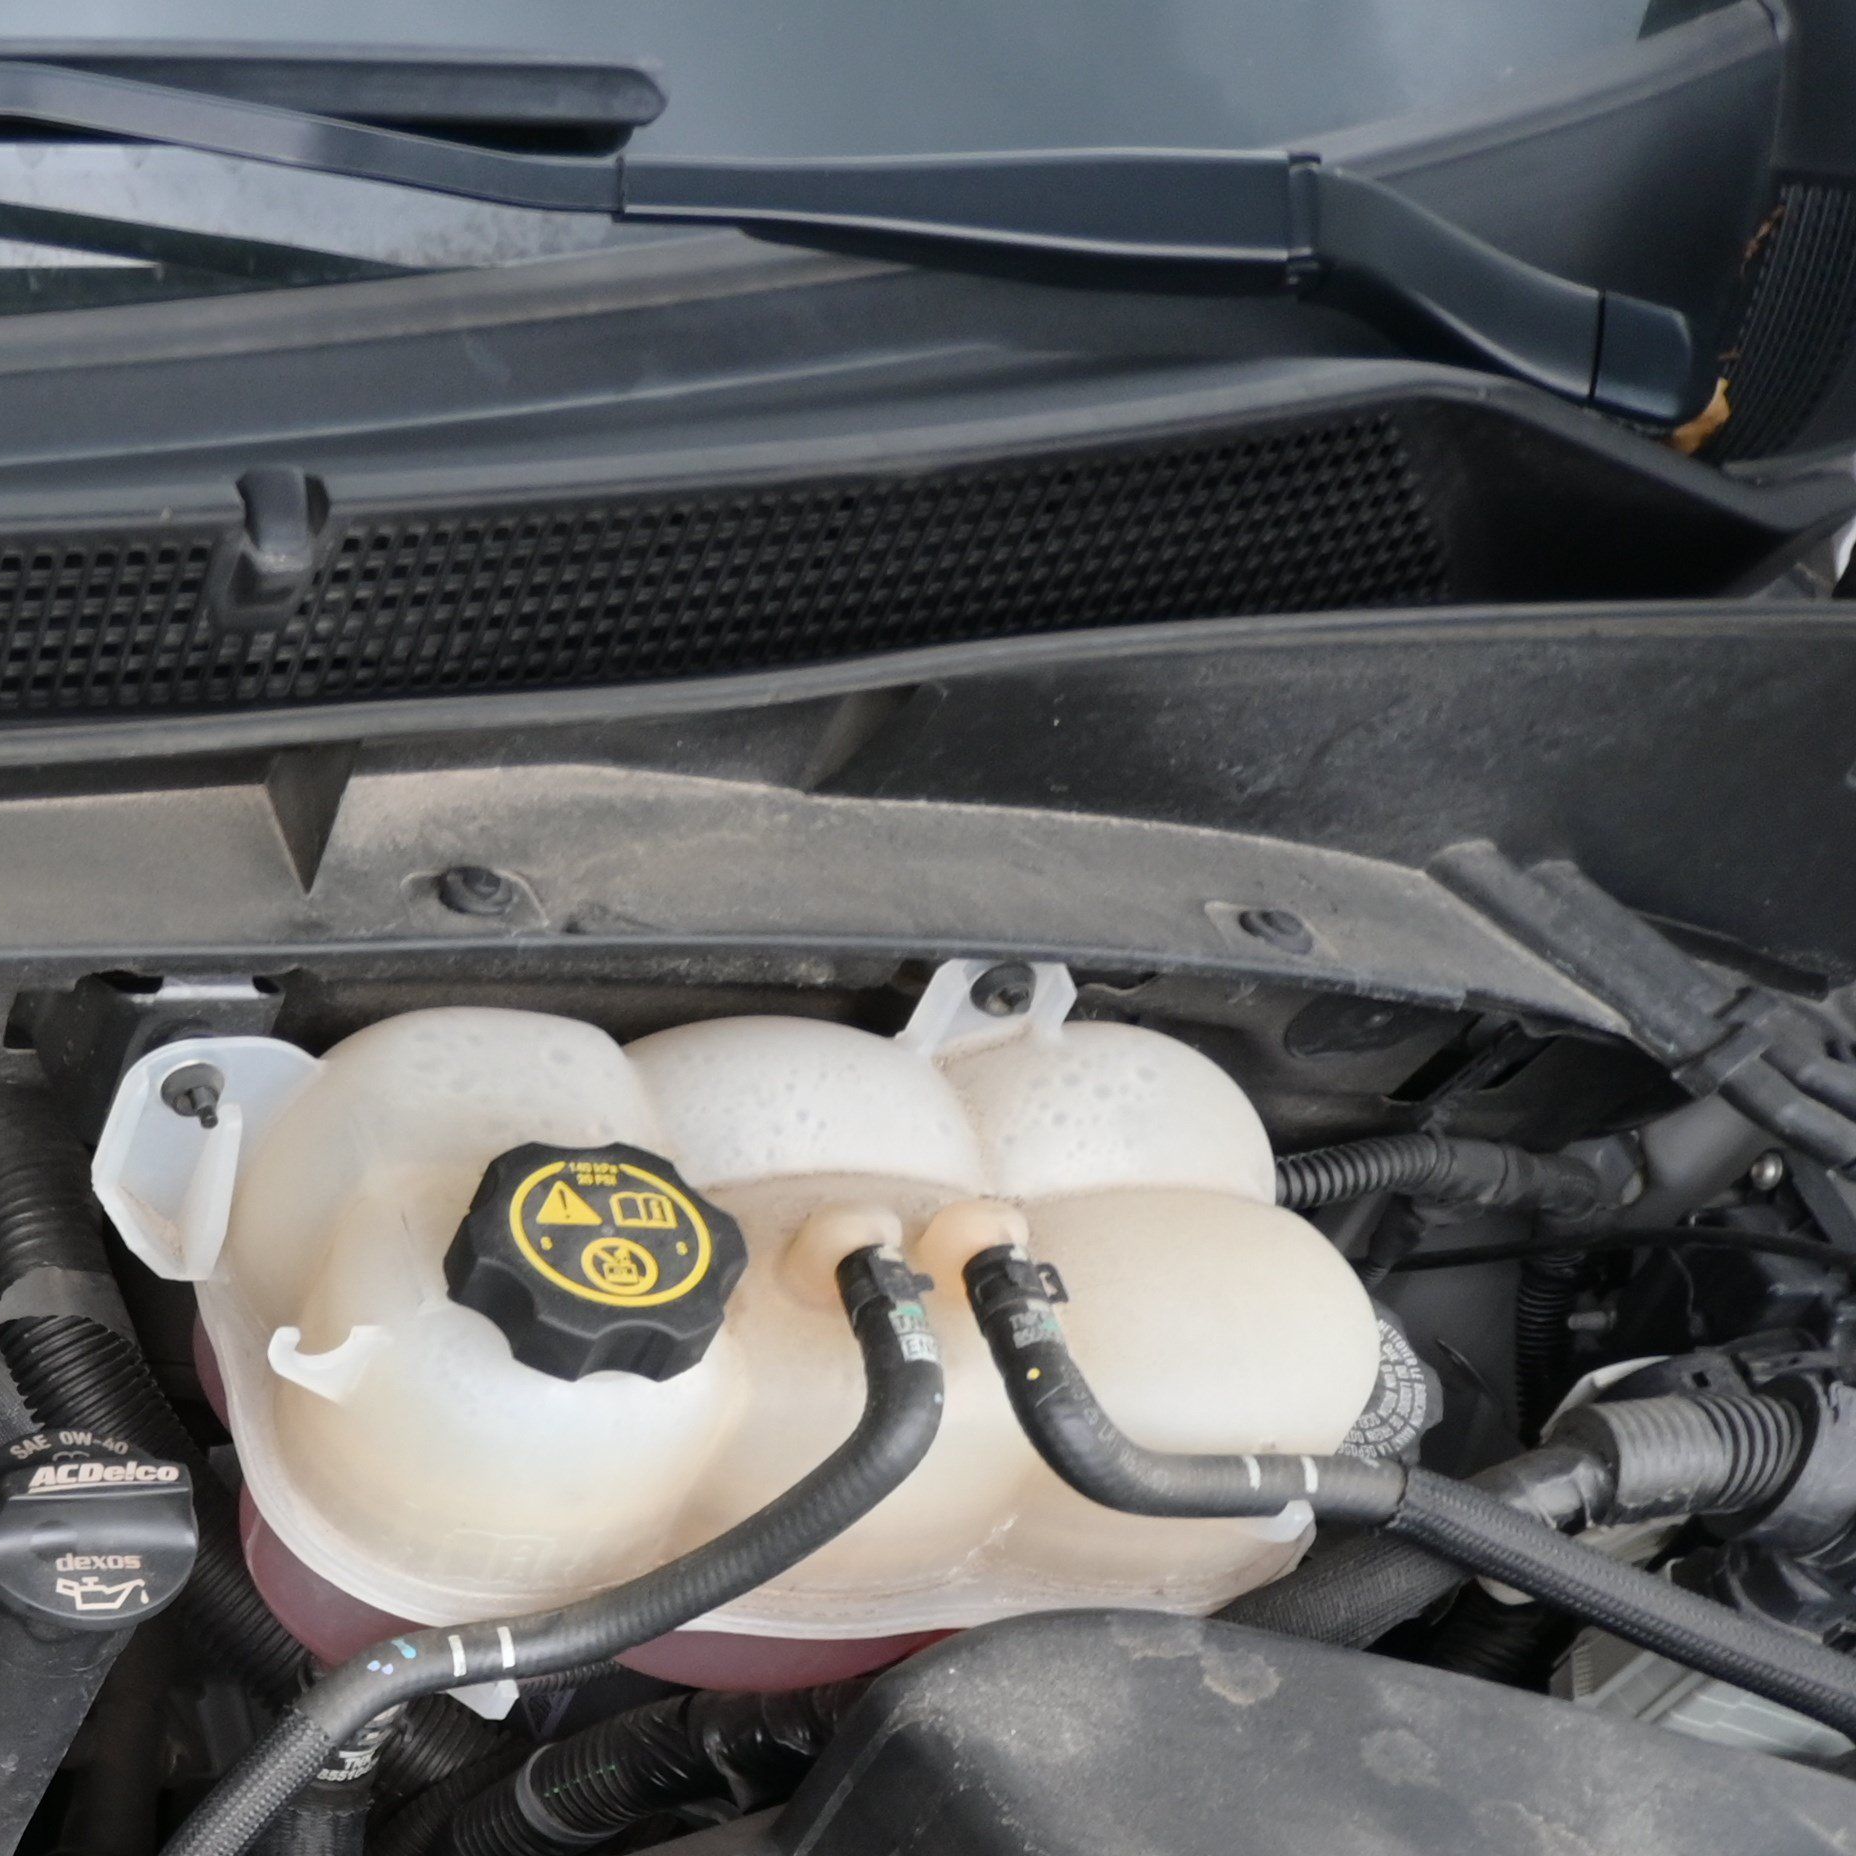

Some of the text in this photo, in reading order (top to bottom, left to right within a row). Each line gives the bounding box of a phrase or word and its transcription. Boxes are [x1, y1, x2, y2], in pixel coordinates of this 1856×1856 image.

[10, 1431, 129, 1459] SAE 0W-40
[28, 1461, 180, 1488] ACDelco
[55, 1552, 142, 1572] dexos
